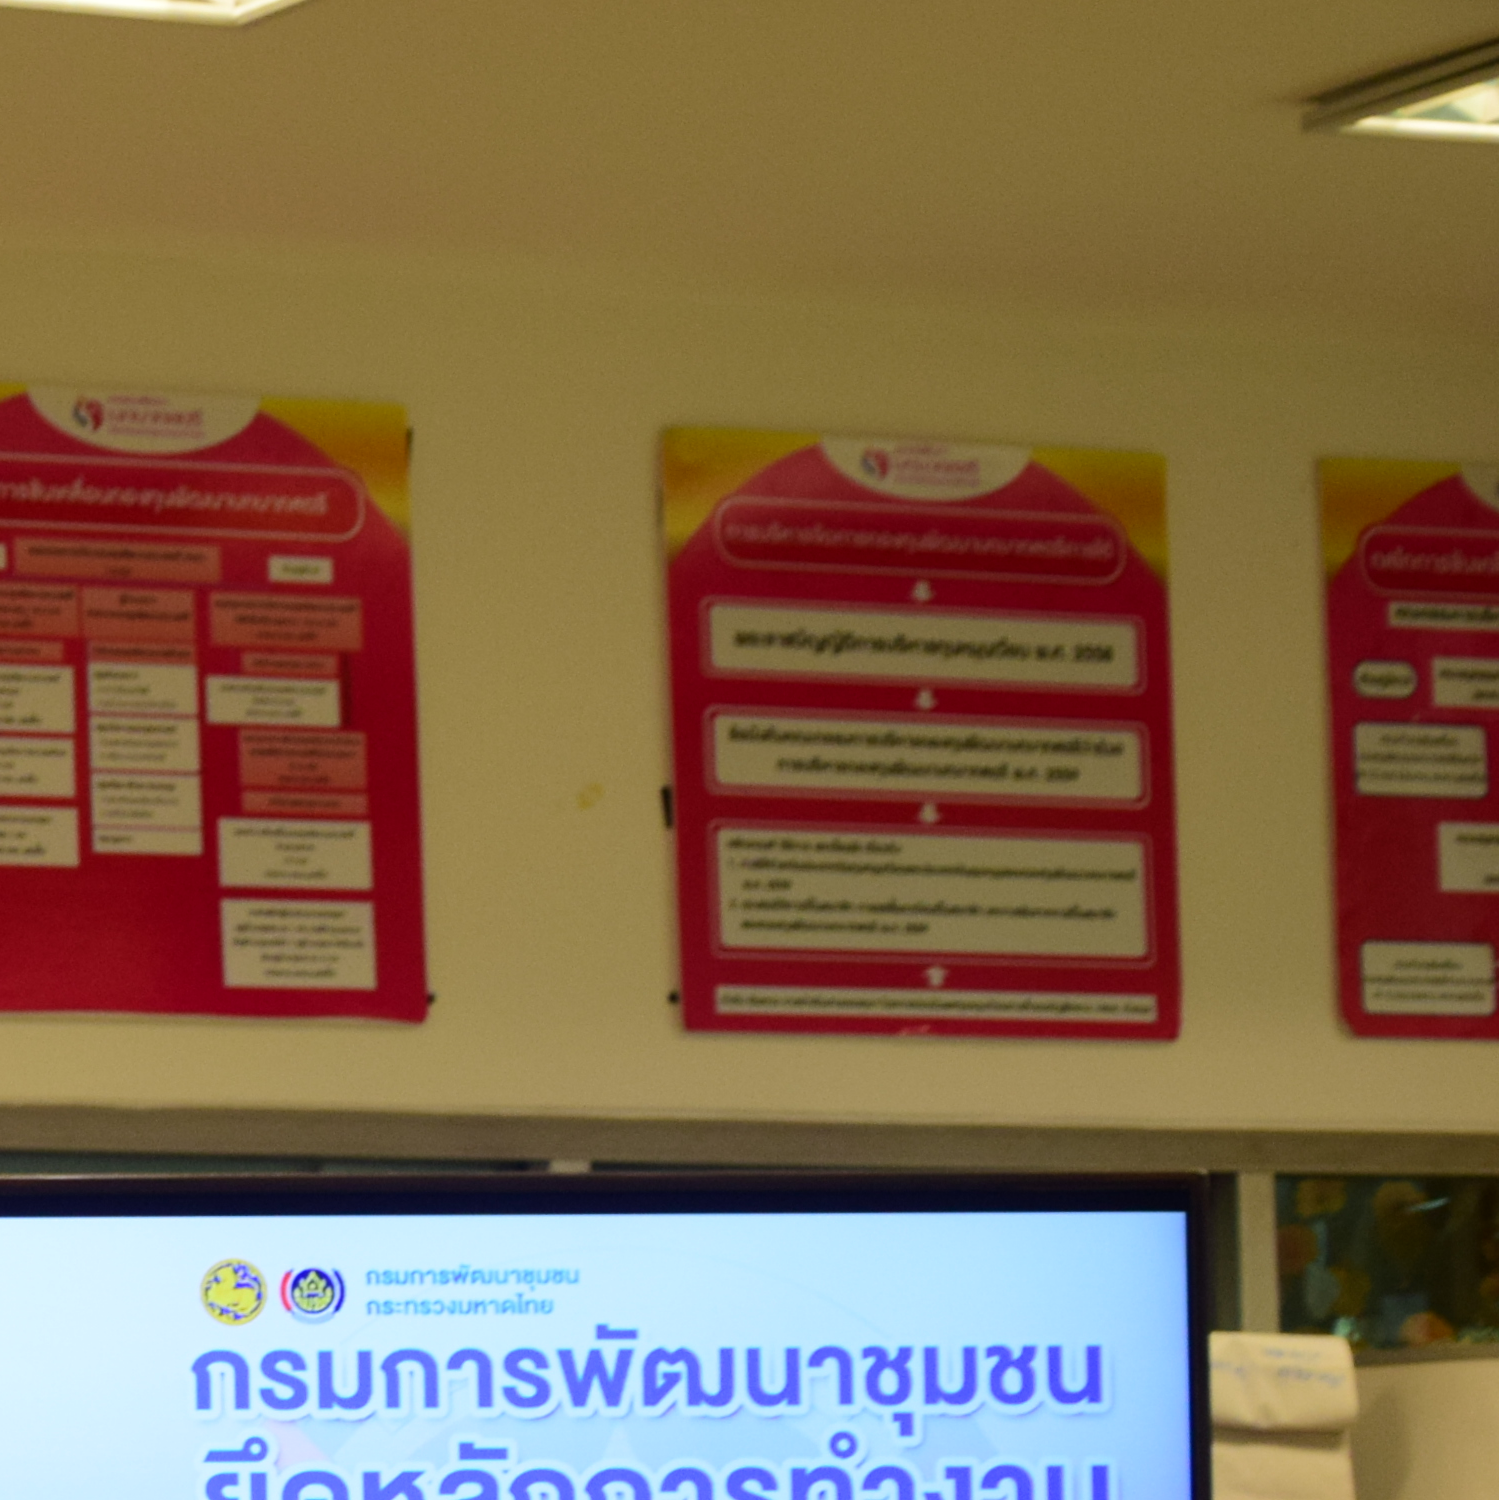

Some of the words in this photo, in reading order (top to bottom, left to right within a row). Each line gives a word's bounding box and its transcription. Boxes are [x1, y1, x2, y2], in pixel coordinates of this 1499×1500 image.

[365, 1262, 581, 1292] กรมการพัฒนาชุมชน
[365, 1290, 555, 1317] กระทรวงมหาดไทย
[189, 1322, 1105, 1437] กรมการพัฒนาชุมชน
